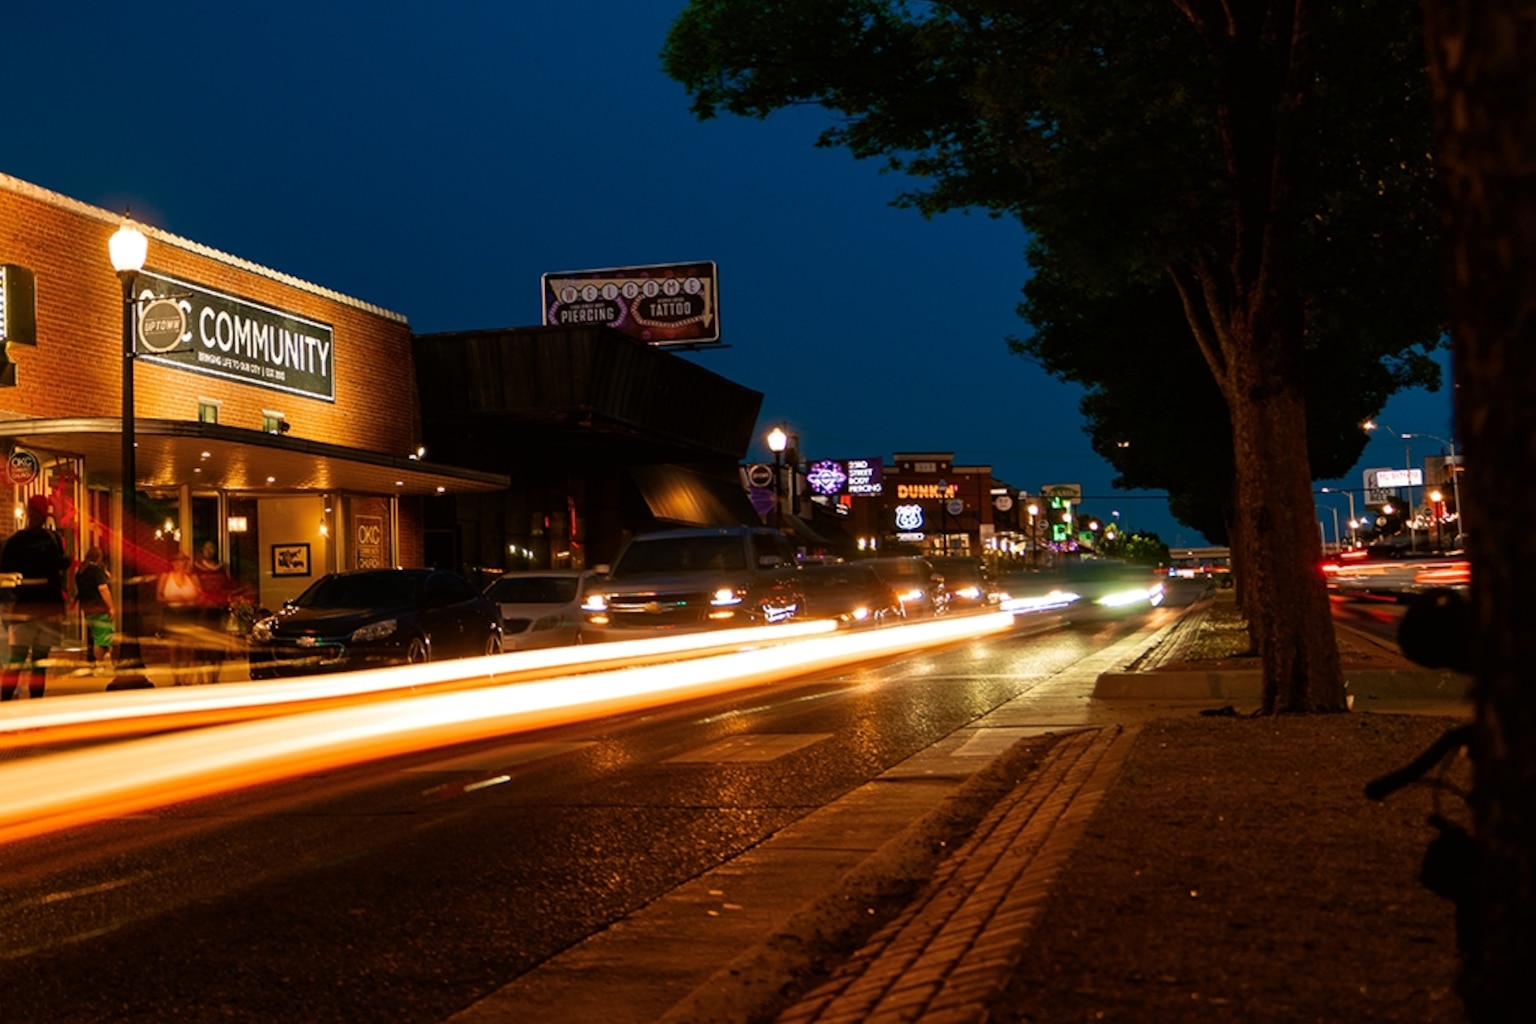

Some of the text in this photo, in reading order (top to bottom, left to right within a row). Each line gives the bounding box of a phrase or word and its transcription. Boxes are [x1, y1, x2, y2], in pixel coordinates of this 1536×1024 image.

[565, 280, 697, 302] WELCOME
[560, 307, 615, 323] PIERCING
[649, 302, 692, 317] TATTOO
[199, 306, 330, 377] COMMUNITY
[898, 484, 959, 499] DUNKN'
[358, 525, 380, 545] OKC
